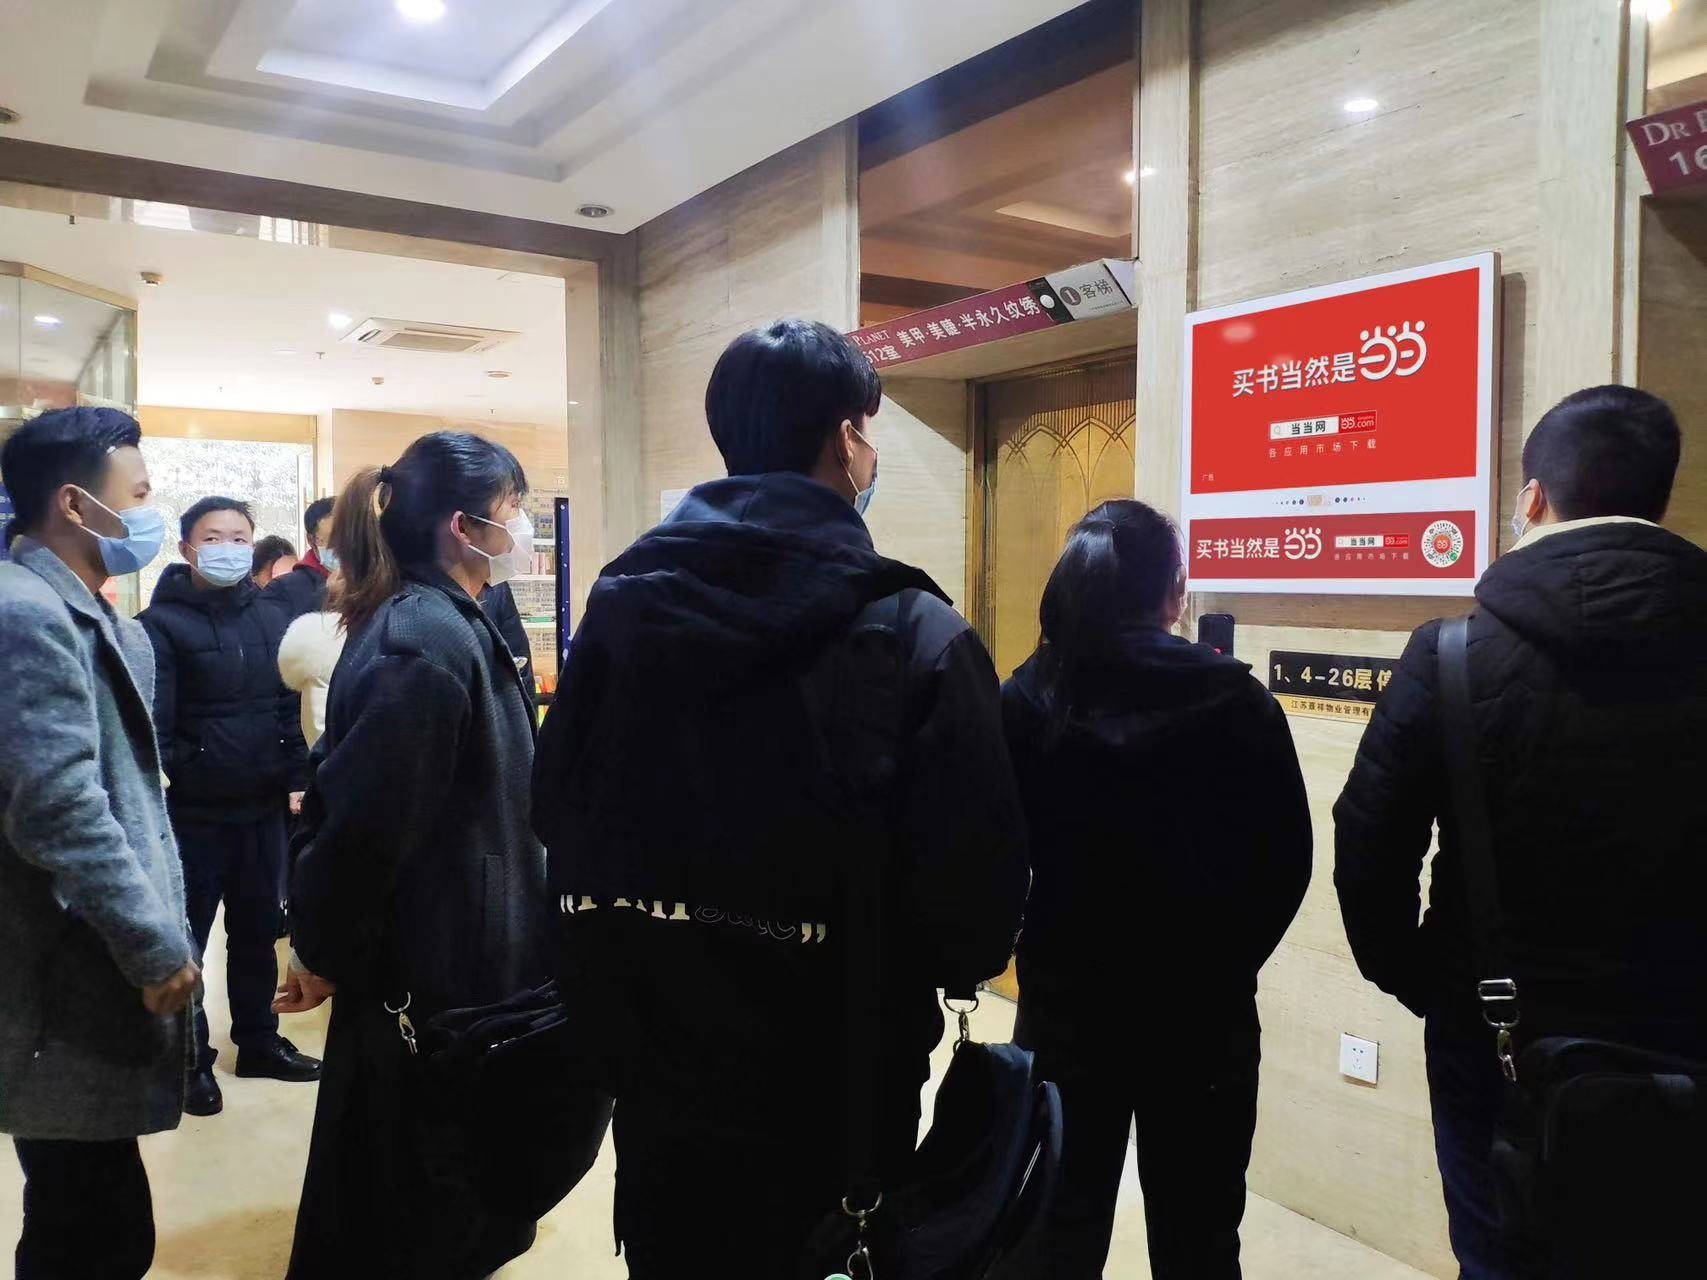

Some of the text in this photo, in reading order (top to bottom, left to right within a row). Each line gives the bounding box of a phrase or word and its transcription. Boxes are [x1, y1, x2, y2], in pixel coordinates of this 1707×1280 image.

[1079, 279, 1113, 299] 客梯
[1232, 352, 1356, 397] 买书当然是
[1291, 420, 1326, 435] 当当网
[1196, 537, 1280, 559] 买书当然是
